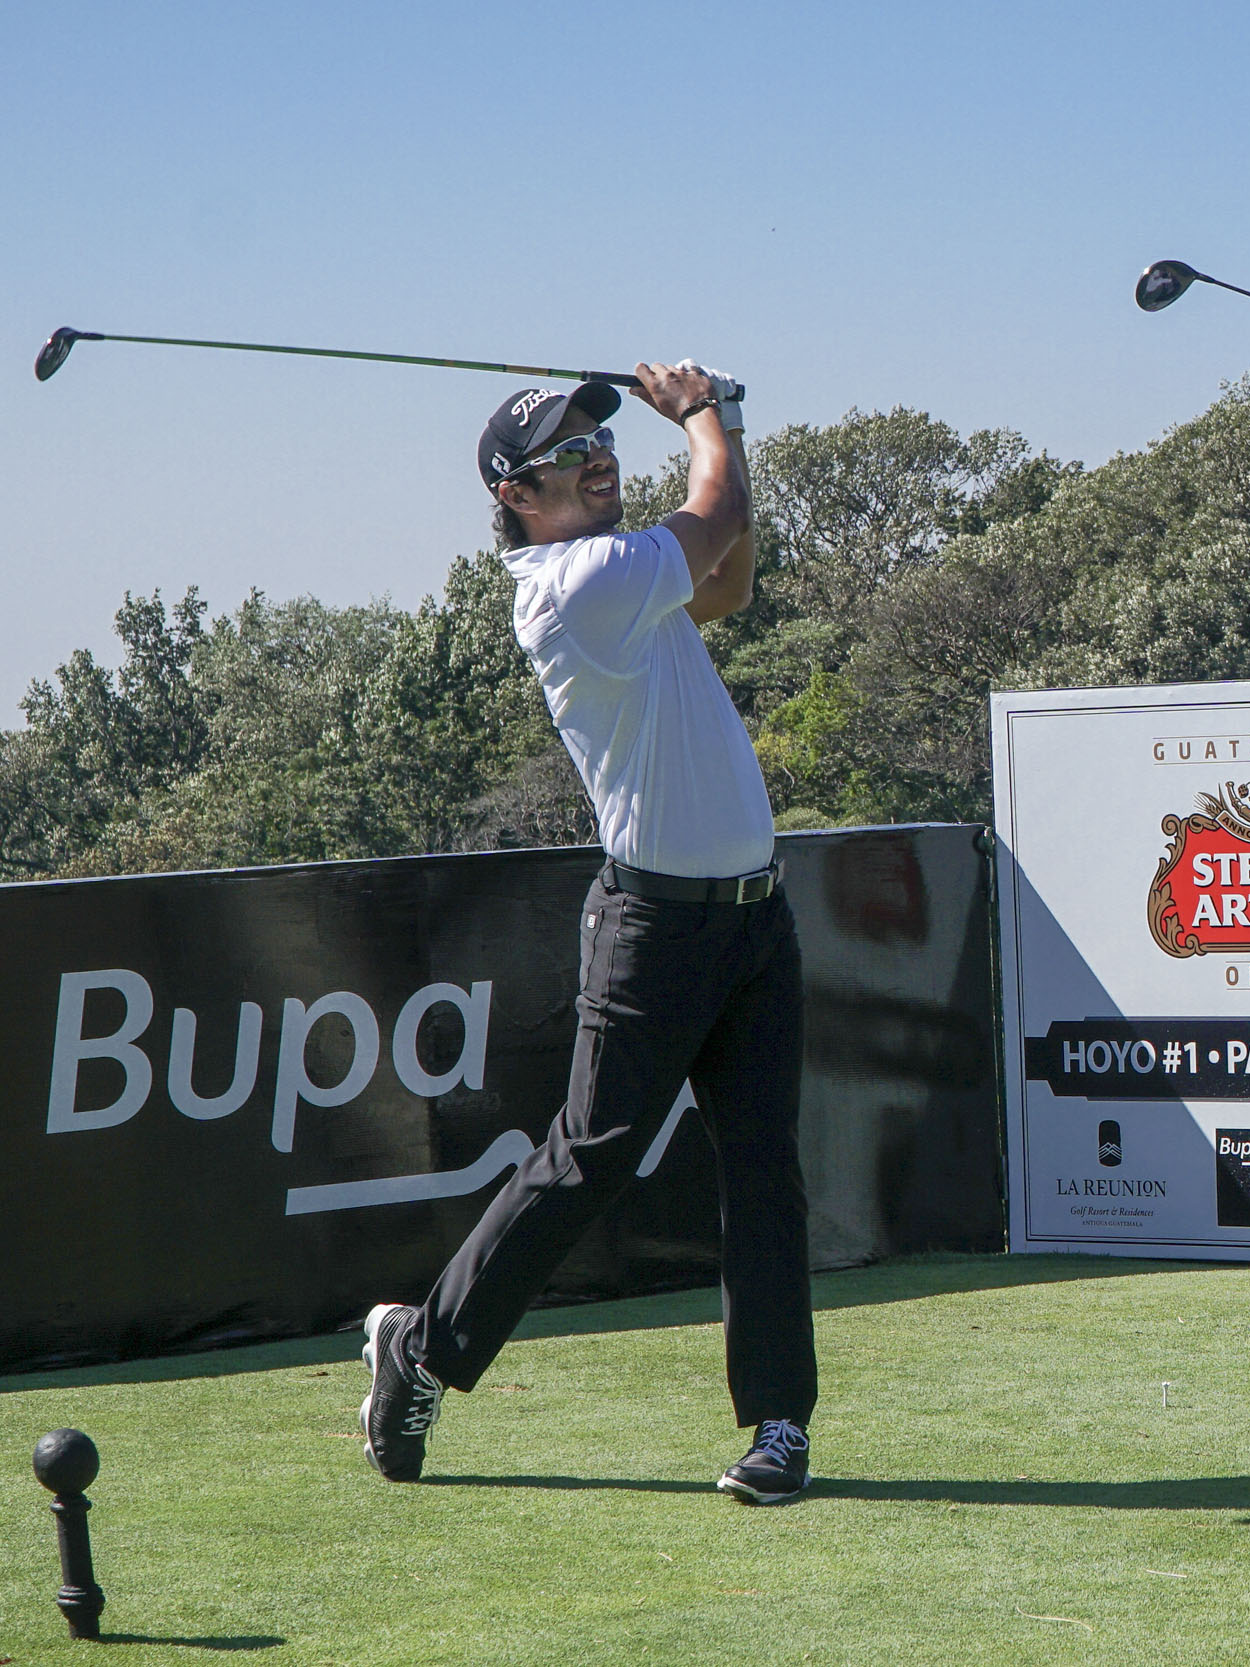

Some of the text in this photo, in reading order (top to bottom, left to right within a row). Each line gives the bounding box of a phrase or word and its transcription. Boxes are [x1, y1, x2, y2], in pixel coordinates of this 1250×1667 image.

[46, 968, 492, 1153] Bupa
[1063, 1040, 1156, 1074] HOYO
[1162, 1041, 1197, 1074] #1
[1056, 1179, 1166, 1198] LA REUNION
[1070, 1206, 1154, 1217] Golf Resort & Residences
